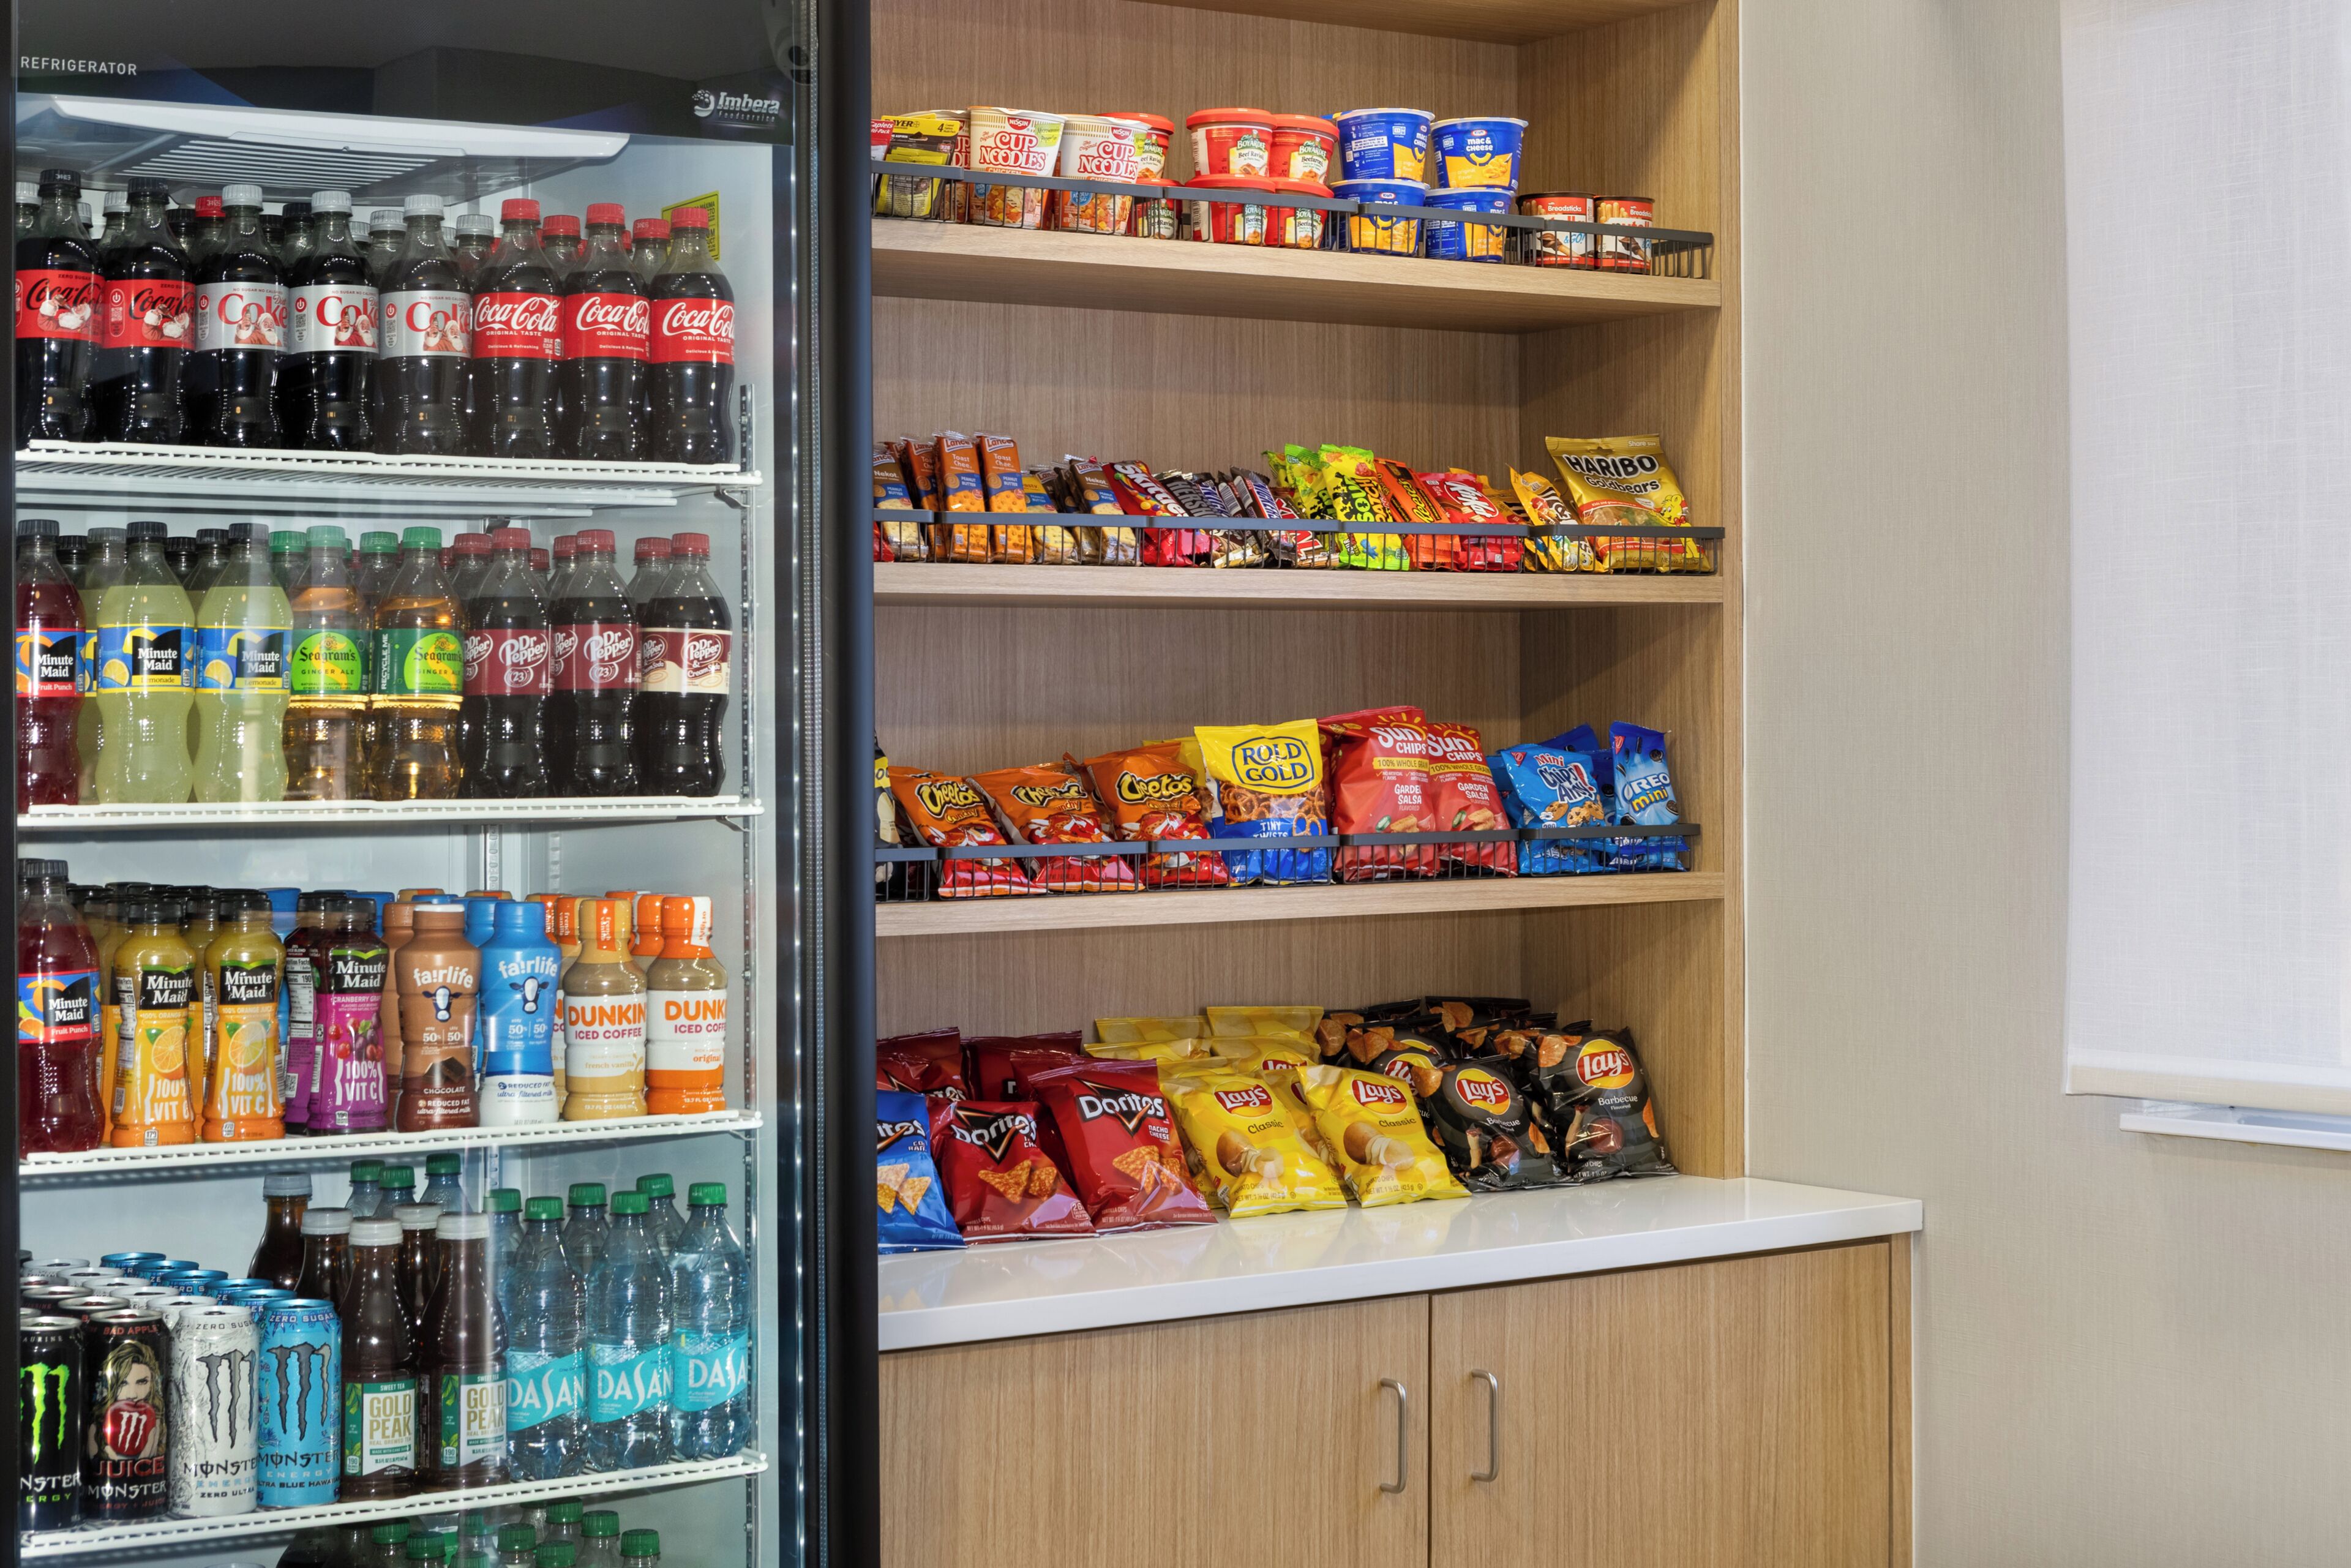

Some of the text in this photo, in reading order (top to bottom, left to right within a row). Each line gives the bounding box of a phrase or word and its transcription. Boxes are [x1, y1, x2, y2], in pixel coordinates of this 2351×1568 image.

[21, 56, 137, 75] REFRIGERATOR
[718, 92, 780, 114] Imbera
[937, 123, 944, 132] 4
[1009, 119, 1029, 127] NISSIN
[994, 131, 1038, 152] CUP
[1237, 140, 1265, 152] BOYARDEE
[1097, 141, 1135, 161] CUP
[1299, 146, 1327, 159] BOYARDEE
[980, 146, 1046, 171] NOODLES
[1301, 156, 1324, 167] Beefaroni
[1078, 155, 1139, 179] NOODLES
[218, 294, 288, 329] Coke
[474, 296, 560, 332] Coca-Cola
[945, 437, 971, 448] Lance
[986, 437, 1011, 448] Lance
[952, 454, 970, 462] Toast
[1562, 454, 1659, 478] HARIBO
[1085, 476, 1107, 485] Nekot
[1584, 475, 1660, 495] Goldbears
[520, 636, 537, 648] Dr
[604, 631, 621, 643] Dr
[699, 639, 712, 649] Dr
[138, 648, 178, 659] Minute
[299, 647, 357, 664] Seagram's
[502, 639, 546, 666] Pepper
[587, 635, 632, 662] Pepper
[689, 642, 720, 660] Pepper
[37, 654, 73, 666] Minute
[242, 650, 280, 662] Minute
[41, 666, 69, 677] Maid
[143, 659, 174, 671] Maid
[247, 662, 275, 673] Maid
[141, 675, 174, 684] Lemonade
[513, 671, 524, 681] 23
[1369, 727, 1422, 748] Sun
[1396, 742, 1426, 754] CHIPS
[1427, 733, 1474, 757] Sun
[1243, 744, 1302, 766] ROLD
[1446, 752, 1483, 762] CHIPS
[1534, 753, 1564, 767] Mini
[1245, 762, 1308, 782] GOLD
[1431, 764, 1451, 773] 100%
[1475, 765, 1491, 774] GRAIN
[1538, 767, 1579, 787] Chips
[1116, 770, 1194, 803] Cheetos
[1457, 782, 1489, 793] GARDEN
[1623, 773, 1670, 800] OREO
[917, 781, 983, 818] Cheetos
[1398, 795, 1422, 805] SALSA
[1465, 790, 1490, 801] SALSA
[1632, 786, 1668, 812] mini
[945, 808, 979, 823] Crunchy
[1260, 821, 1281, 831] TINY
[336, 961, 386, 974] Minute
[147, 975, 193, 989] Minute
[225, 972, 272, 985] Minute
[343, 974, 381, 988] Maid
[154, 990, 187, 1003] Maid
[231, 985, 266, 999] Maid
[48, 997, 88, 1010] Minute
[55, 1008, 84, 1022] Maid
[576, 1027, 642, 1040] ICED COFFEE
[675, 1024, 702, 1033] ICED
[693, 1054, 721, 1065] original
[1583, 1049, 1630, 1081] Lay's
[345, 1060, 377, 1079] 100%
[231, 1073, 266, 1092] 100%
[345, 1081, 377, 1101] VIT C
[1357, 1078, 1402, 1104] Lay's
[1463, 1076, 1504, 1105] Lay's
[231, 1095, 264, 1113] VIT C
[1217, 1087, 1269, 1109] Lay's
[1598, 1095, 1638, 1106] Barbecue
[154, 1101, 179, 1121] VIT
[1077, 1094, 1165, 1121] Doritos
[1248, 1119, 1284, 1135] Classic
[1379, 1117, 1417, 1127] Classic
[1487, 1117, 1521, 1127] Barbecue
[951, 1113, 1037, 1147] Doritos
[1149, 1125, 1168, 1134] NACHO
[1149, 1132, 1170, 1141] CHEESE
[269, 1313, 334, 1322] ZERO SUGAR
[103, 1327, 124, 1335] BAD
[467, 1385, 504, 1409] GOLD
[369, 1394, 412, 1418] GOLD
[467, 1408, 504, 1431] PEAK
[369, 1415, 412, 1439] PEAK
[258, 1450, 339, 1468] MONSTER
[97, 1455, 165, 1479] JUICE
[267, 1467, 332, 1477] ENERGY
[88, 1480, 167, 1499] MONSTER
[232, 1487, 255, 1496] ULTRA
